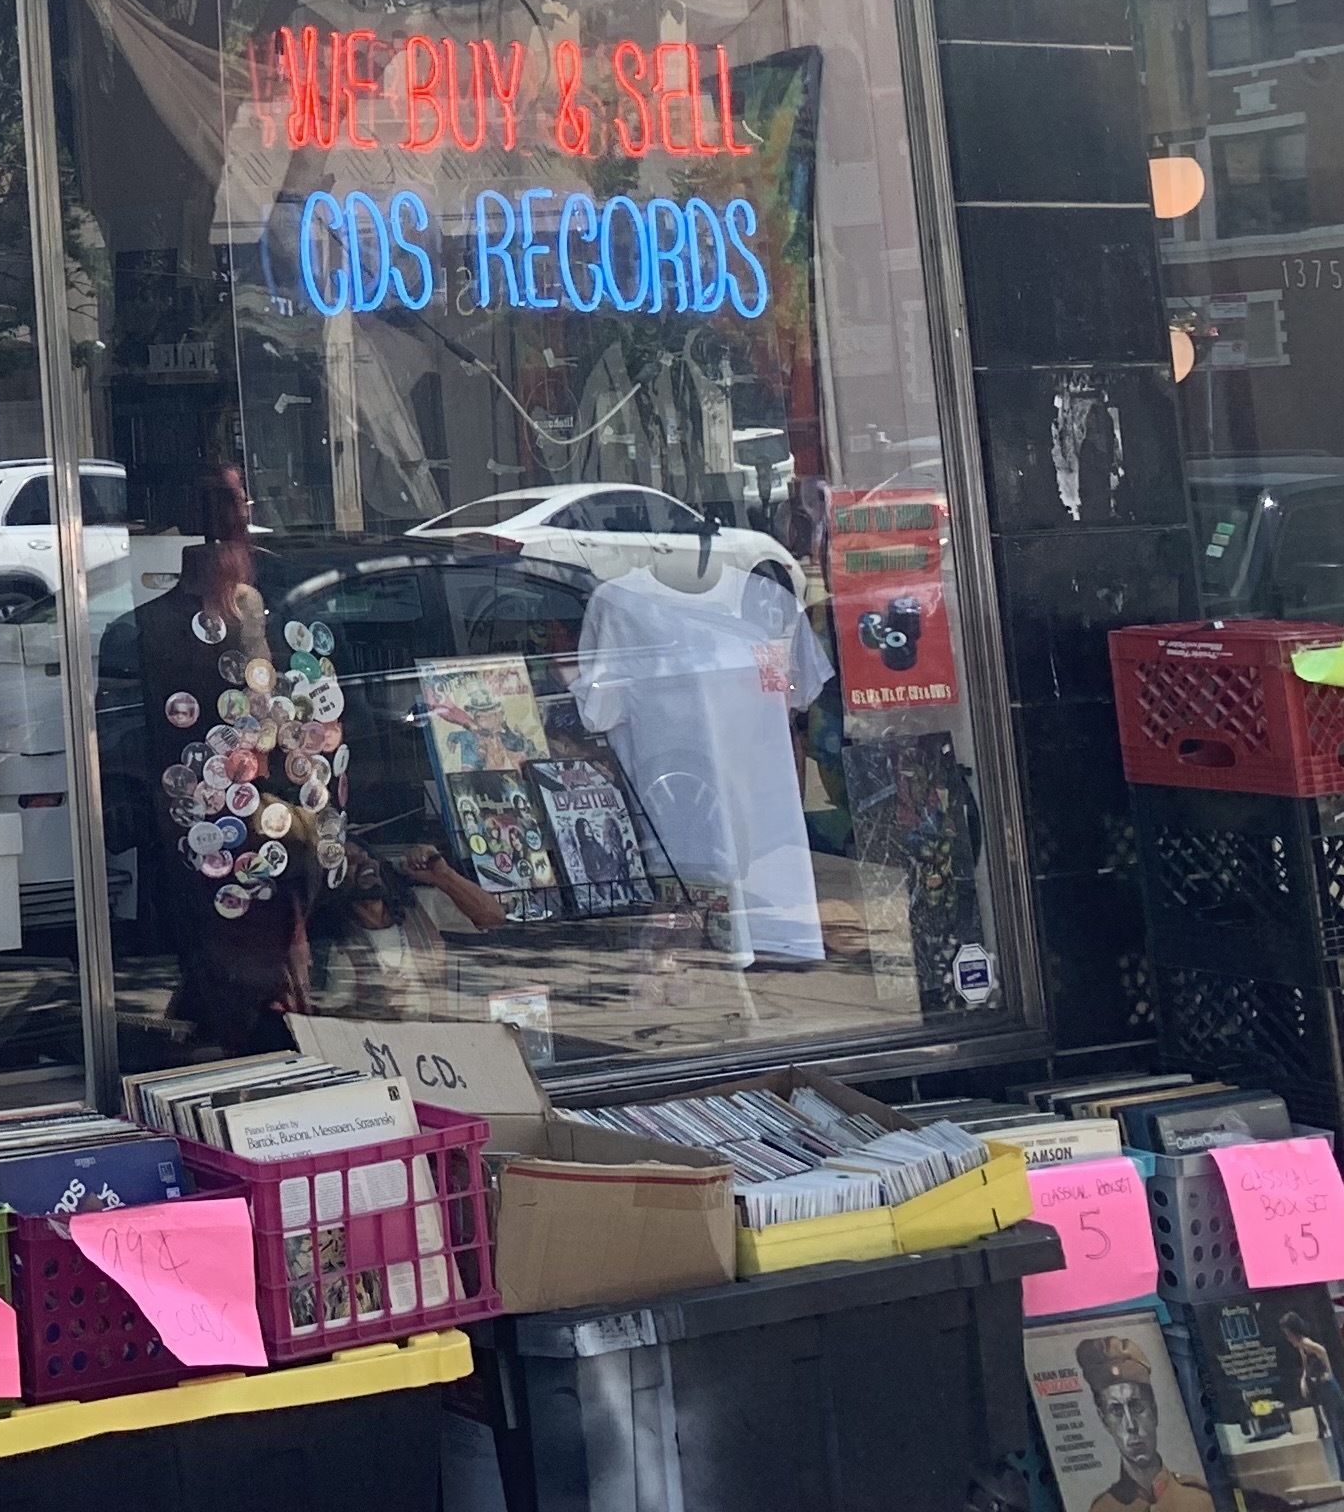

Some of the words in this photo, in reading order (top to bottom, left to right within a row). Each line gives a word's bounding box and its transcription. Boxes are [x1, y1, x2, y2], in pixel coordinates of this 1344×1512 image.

[280, 24, 379, 151] WE
[399, 34, 524, 153] BUY
[554, 38, 591, 157] &
[612, 38, 753, 157] SELL
[300, 189, 433, 318] CDS
[474, 186, 770, 321] RECORDS
[1280, 258, 1343, 289] 1375
[1024, 1146, 1073, 1165] SAMSON
[1079, 1207, 1112, 1260] 5
